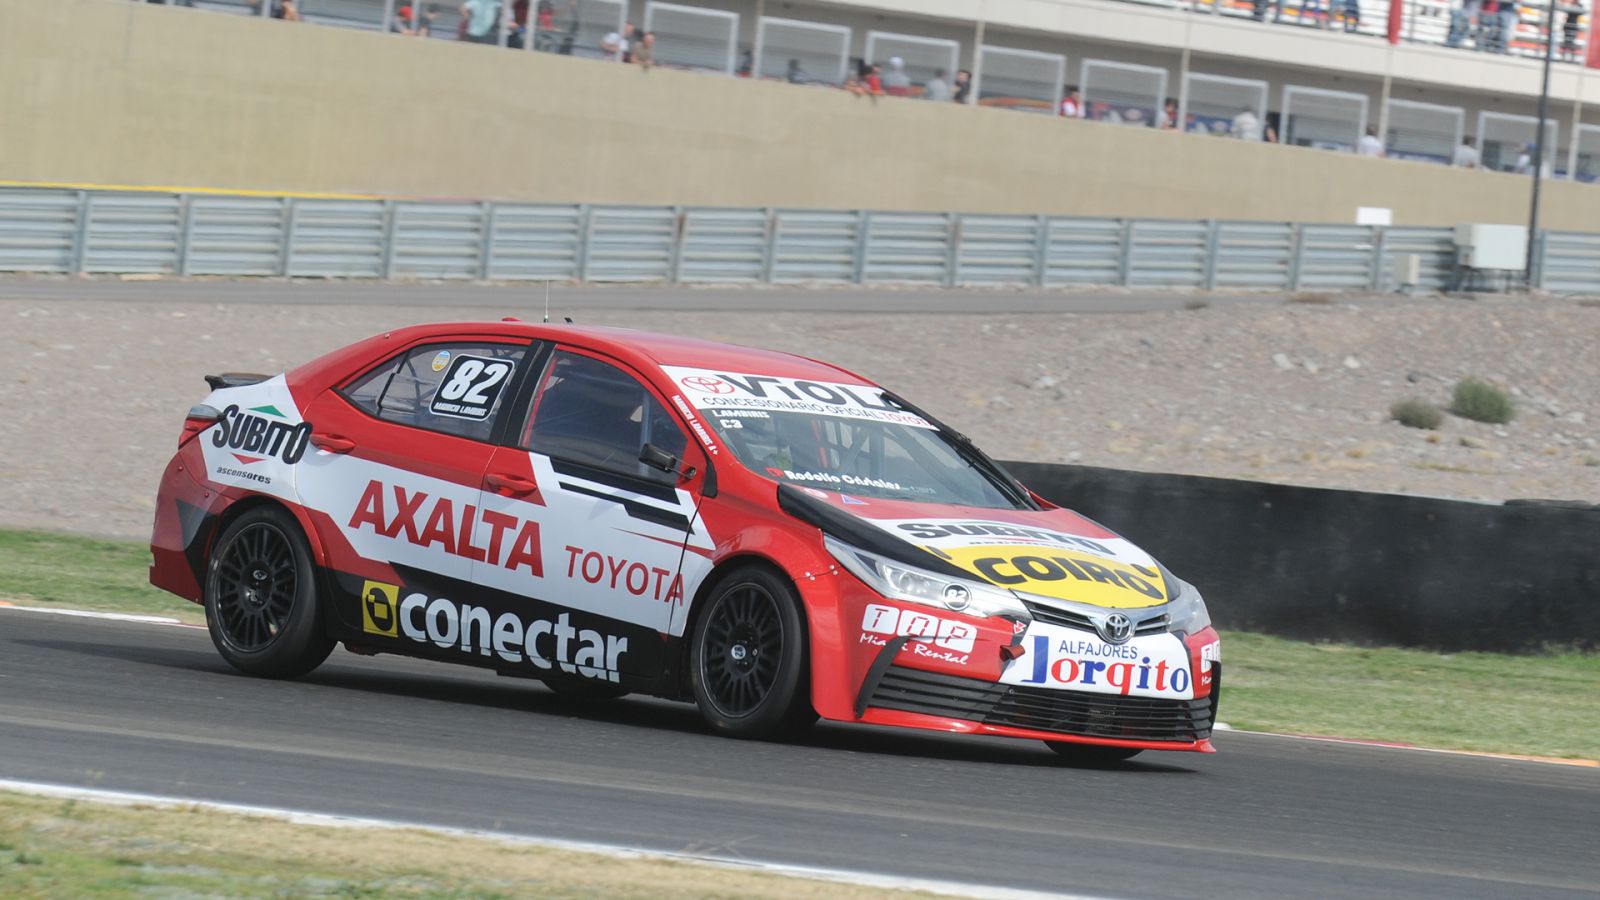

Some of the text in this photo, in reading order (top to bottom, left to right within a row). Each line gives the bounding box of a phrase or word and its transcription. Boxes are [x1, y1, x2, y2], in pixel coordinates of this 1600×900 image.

[441, 360, 509, 404] 82
[702, 397, 825, 413] CONCESIONARIO
[829, 405, 880, 418] OFICIAL
[720, 419, 743, 428] C3
[212, 404, 313, 465] SUBITO
[216, 466, 272, 485] ascensores
[783, 470, 840, 483] Rodolfo
[348, 479, 545, 579] AXALTA
[897, 523, 1117, 555] SUBITO
[565, 545, 685, 607] TOYOTA
[973, 555, 1165, 600] COIRO
[947, 589, 967, 603] 82
[400, 592, 628, 683] conectar
[860, 632, 970, 665] Miai Rental
[1058, 639, 1138, 660] ALFAJORES
